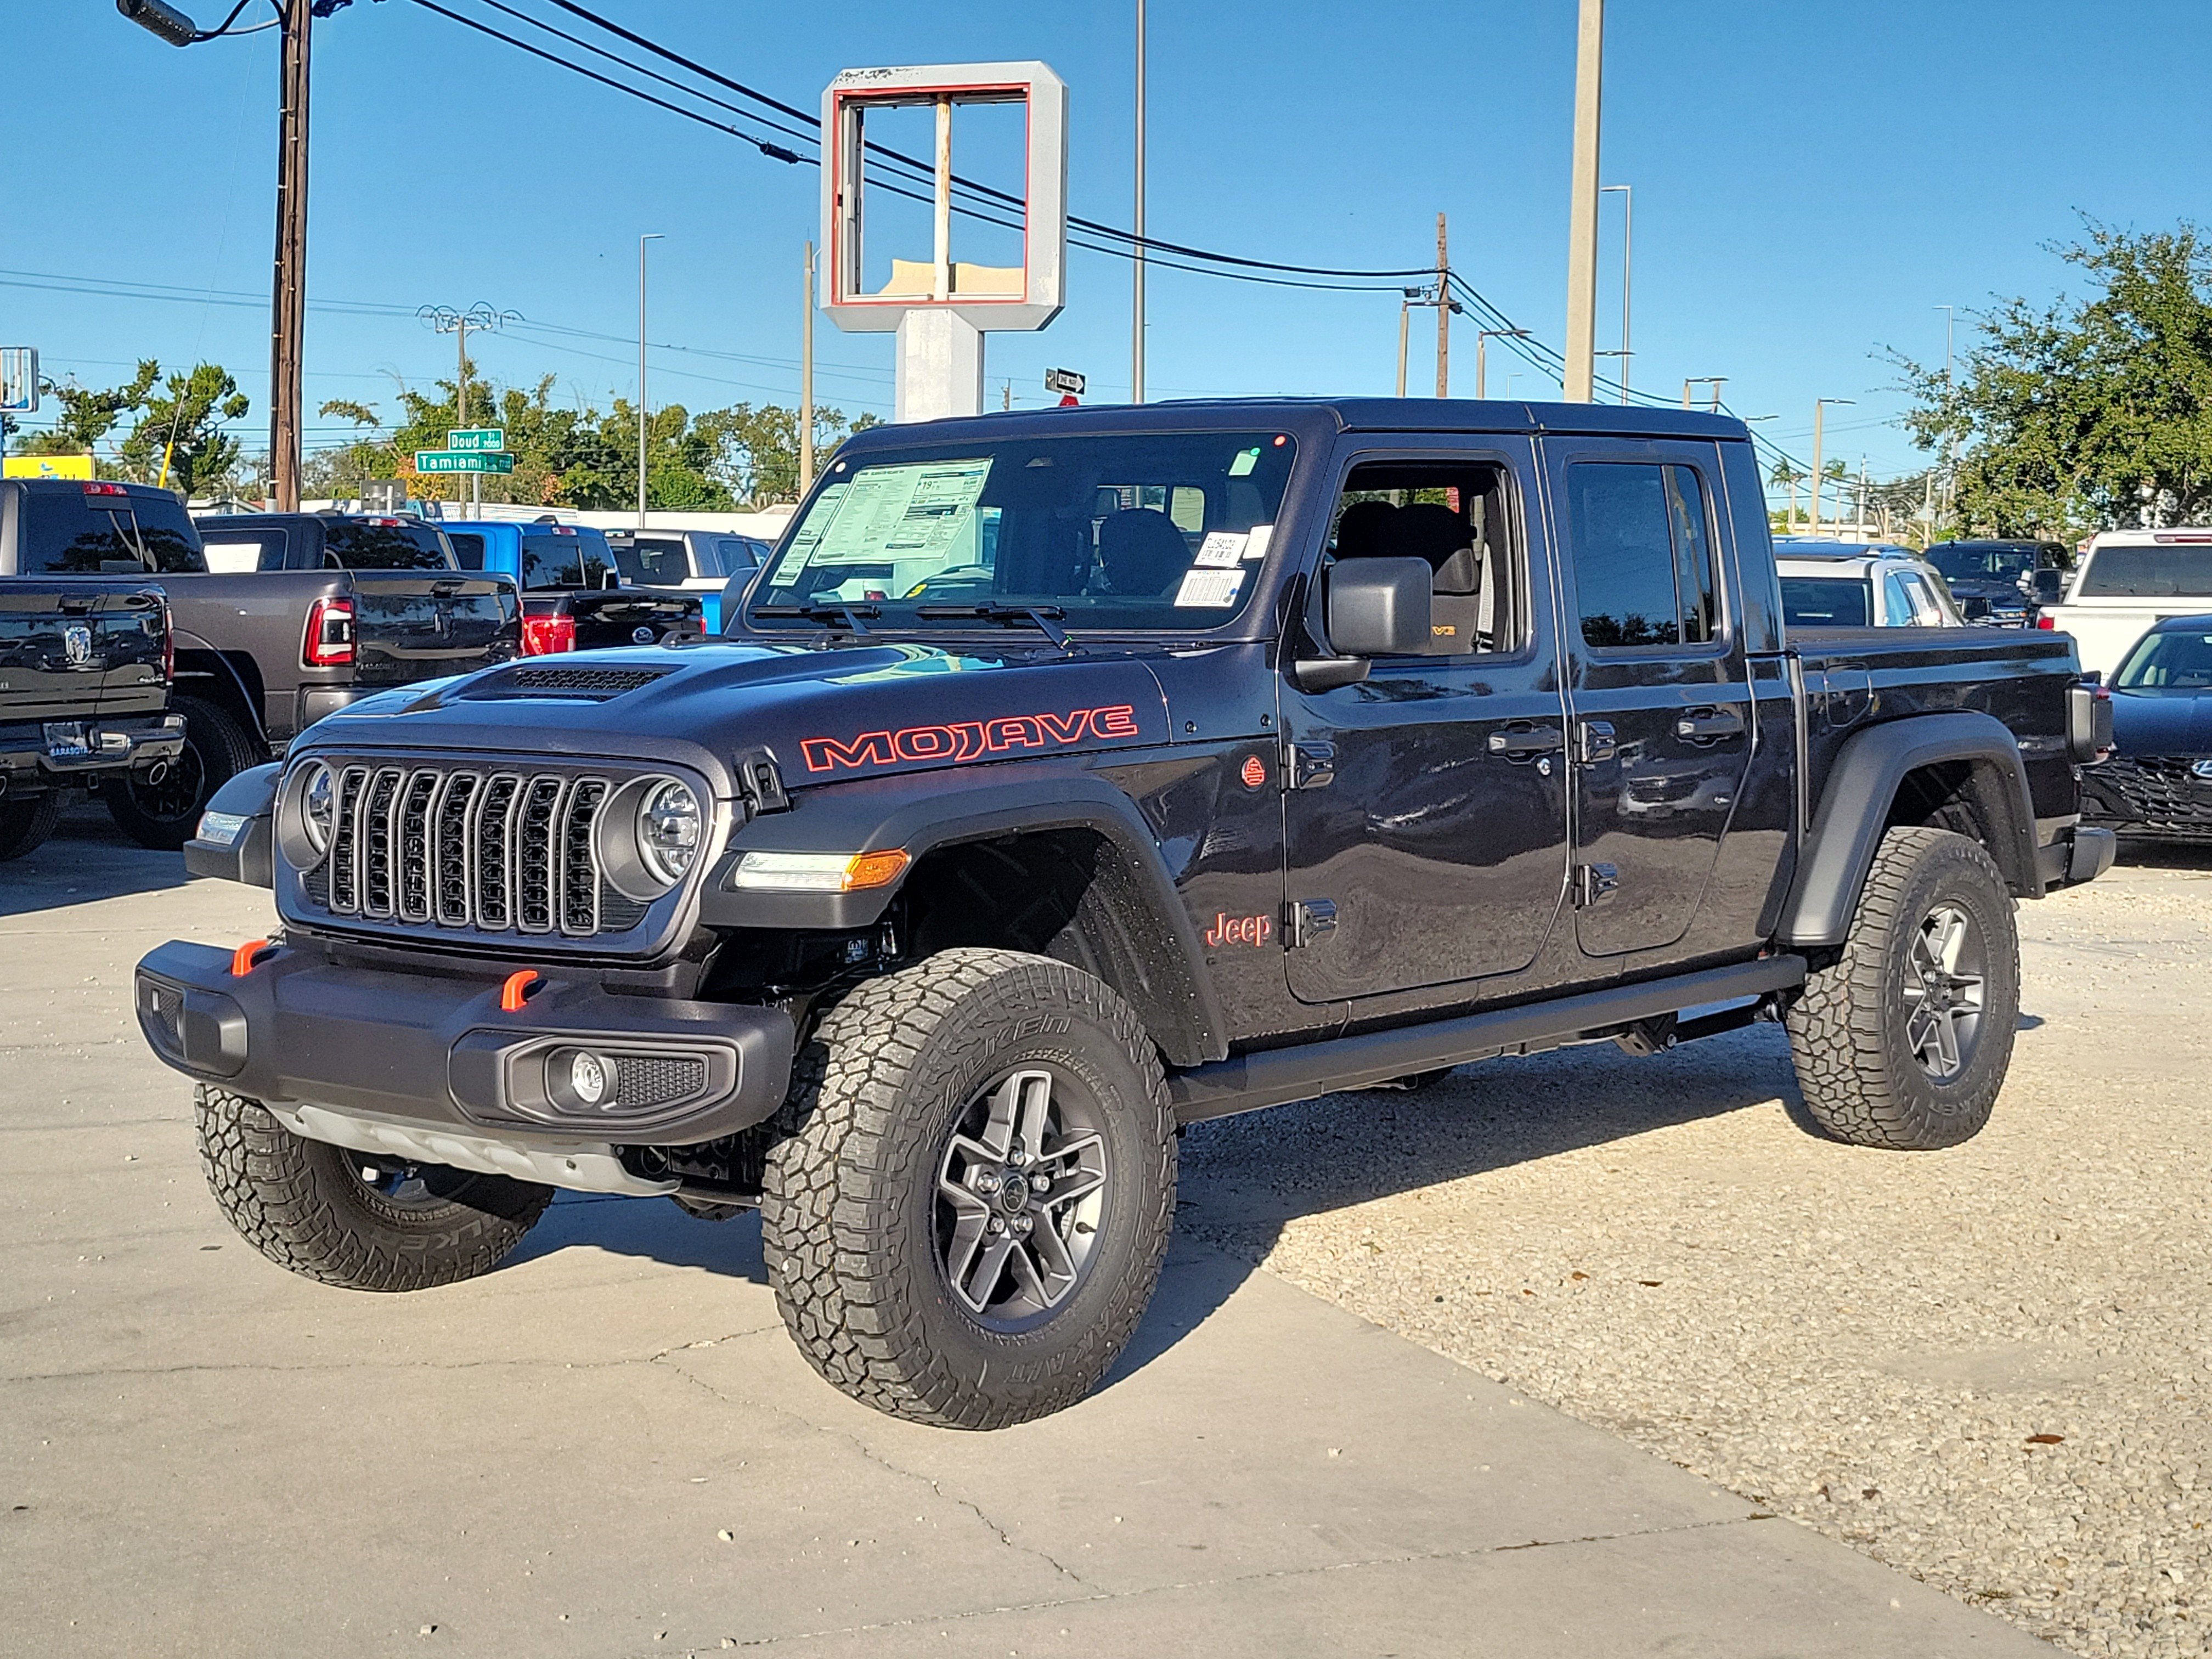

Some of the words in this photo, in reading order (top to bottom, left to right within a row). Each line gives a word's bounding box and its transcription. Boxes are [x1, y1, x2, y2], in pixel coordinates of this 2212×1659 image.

[452, 435, 479, 448] Doud
[421, 455, 481, 469] Tamiami
[800, 705, 1138, 772] MOJAVE
[1207, 912, 1271, 947] Jeep
